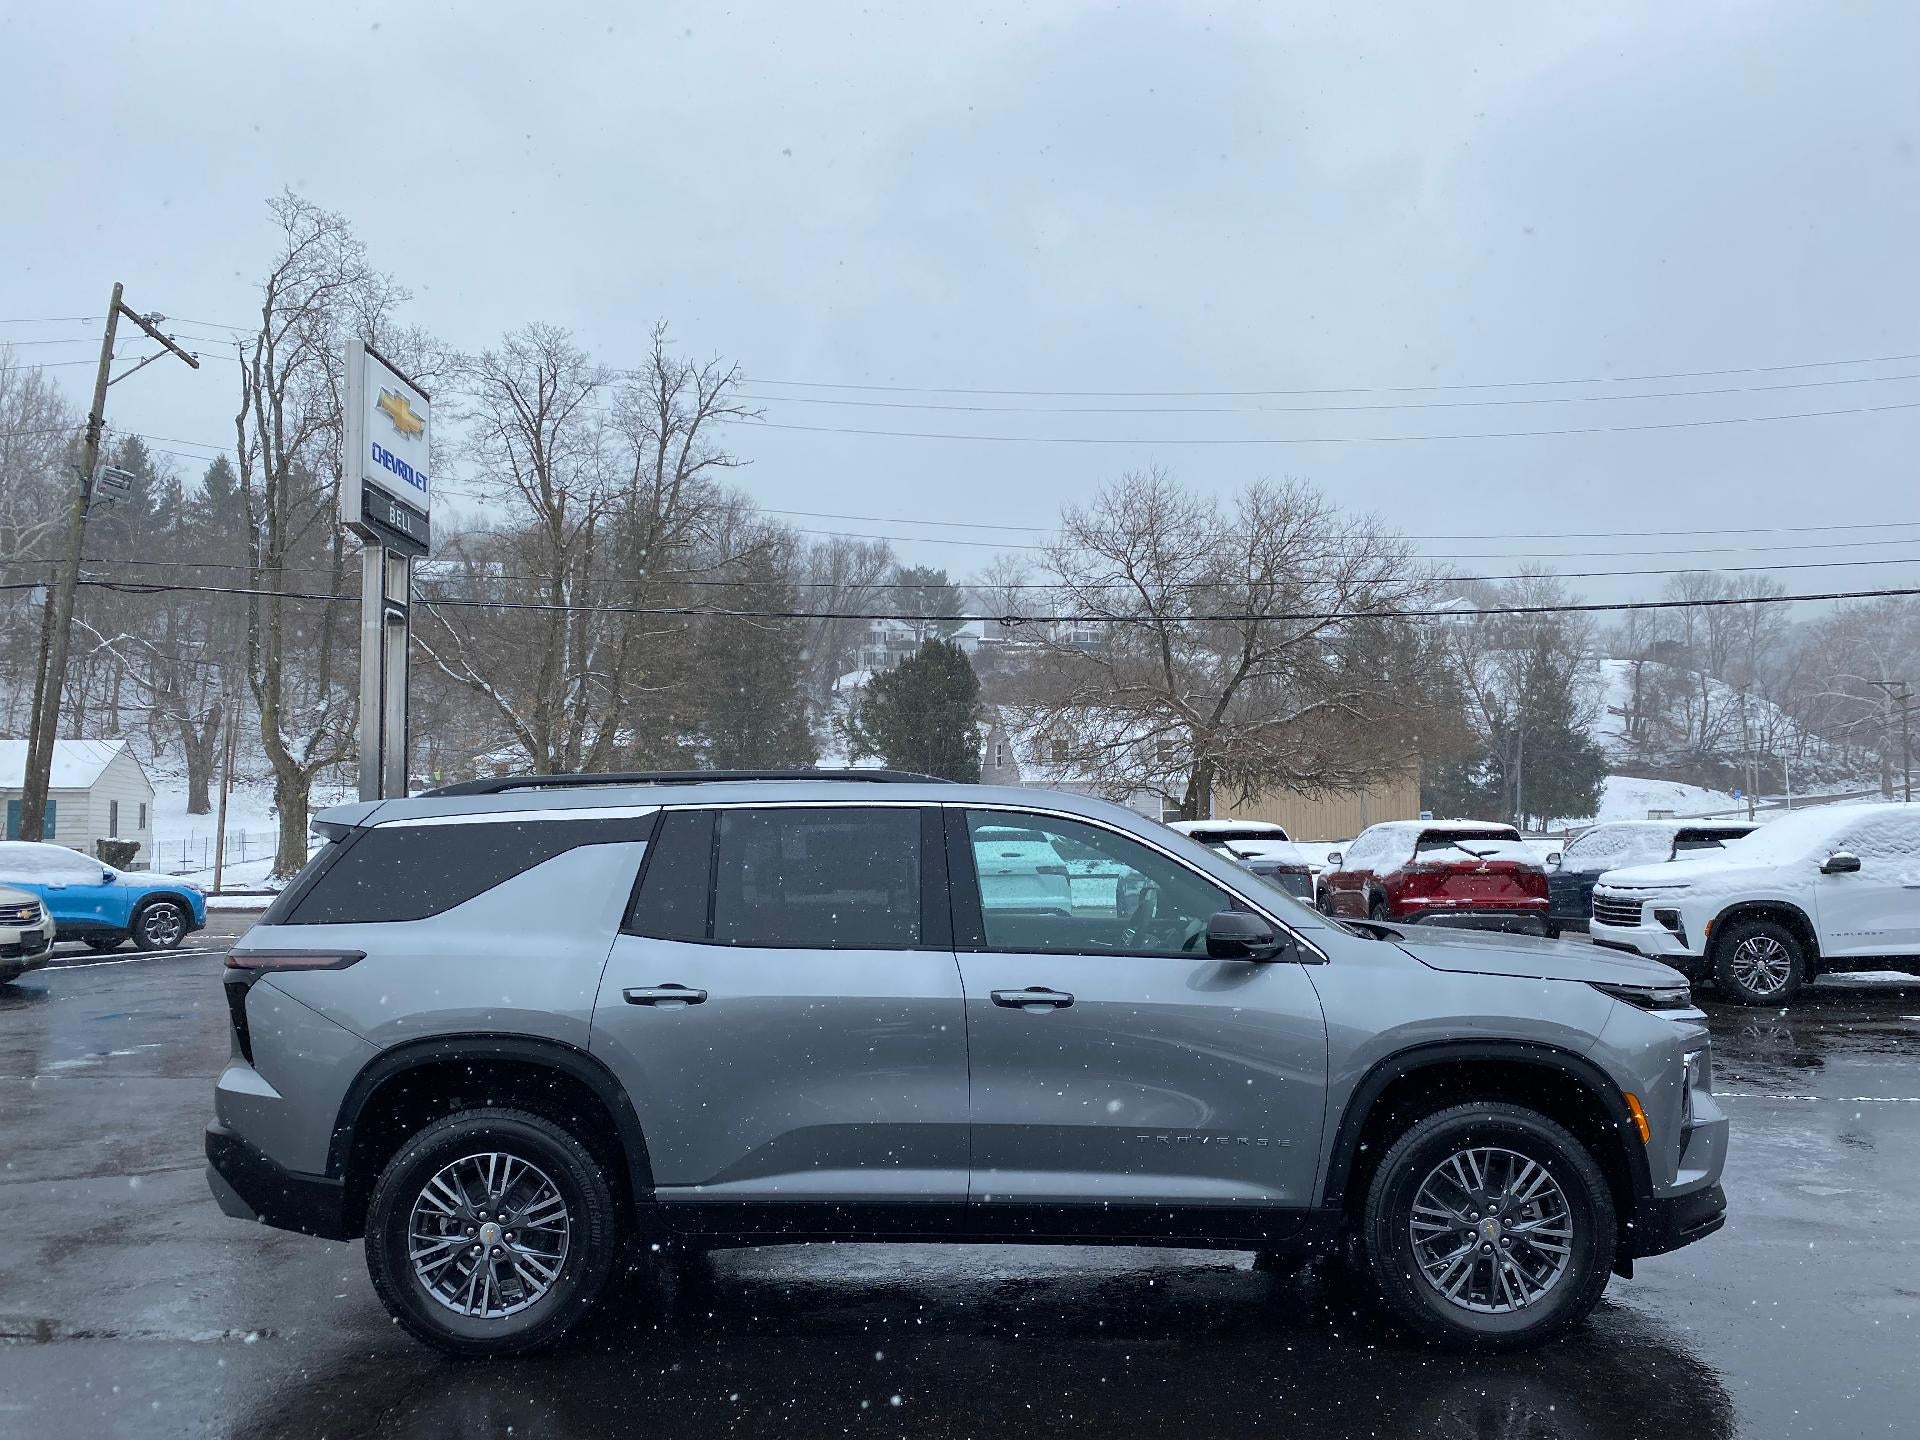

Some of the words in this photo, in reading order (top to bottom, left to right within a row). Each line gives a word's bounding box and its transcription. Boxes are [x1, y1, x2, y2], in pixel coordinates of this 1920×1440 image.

[372, 441, 427, 493] CHEVROLET
[389, 506, 413, 534] BELL
[1136, 1135, 1292, 1147] TRAVERSE
